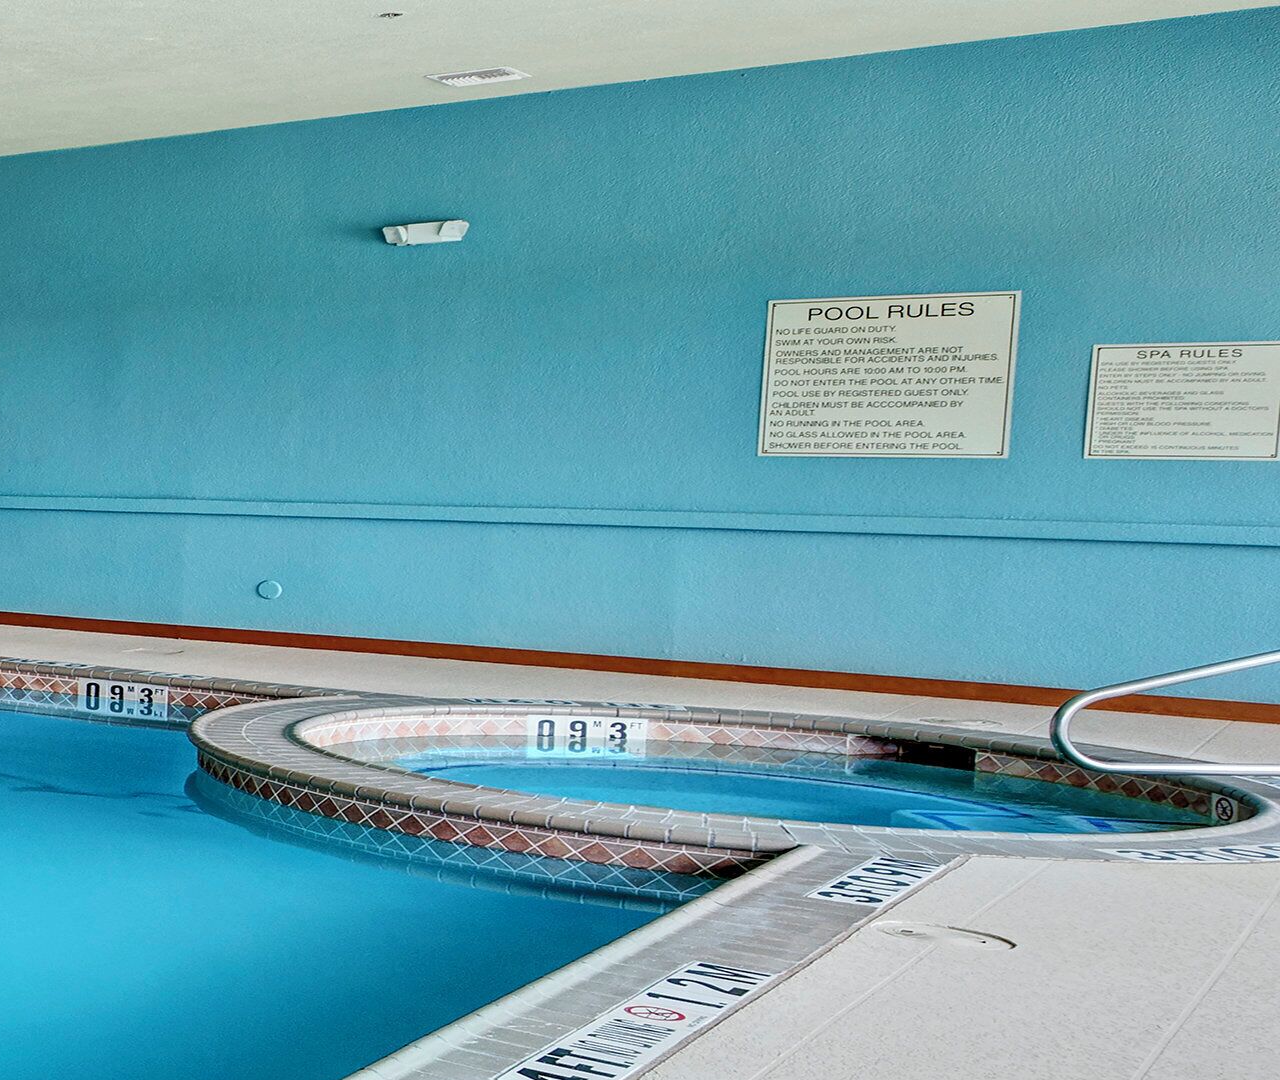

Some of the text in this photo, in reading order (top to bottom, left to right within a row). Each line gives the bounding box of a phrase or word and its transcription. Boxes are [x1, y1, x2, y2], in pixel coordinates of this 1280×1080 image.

[808, 302, 975, 321] POOL RULES
[775, 339, 800, 347] SWIM
[846, 337, 870, 345] OWN
[776, 350, 818, 358] OWNERS
[820, 349, 841, 357] AND
[843, 348, 914, 356] MANAGEMENT
[1136, 349, 1243, 359] SPA RULES
[776, 357, 841, 365] RESPONSIBLE
[867, 355, 924, 363] ACCIDENTS
[838, 389, 901, 397] REGISTERED
[609, 722, 628, 739] 3
